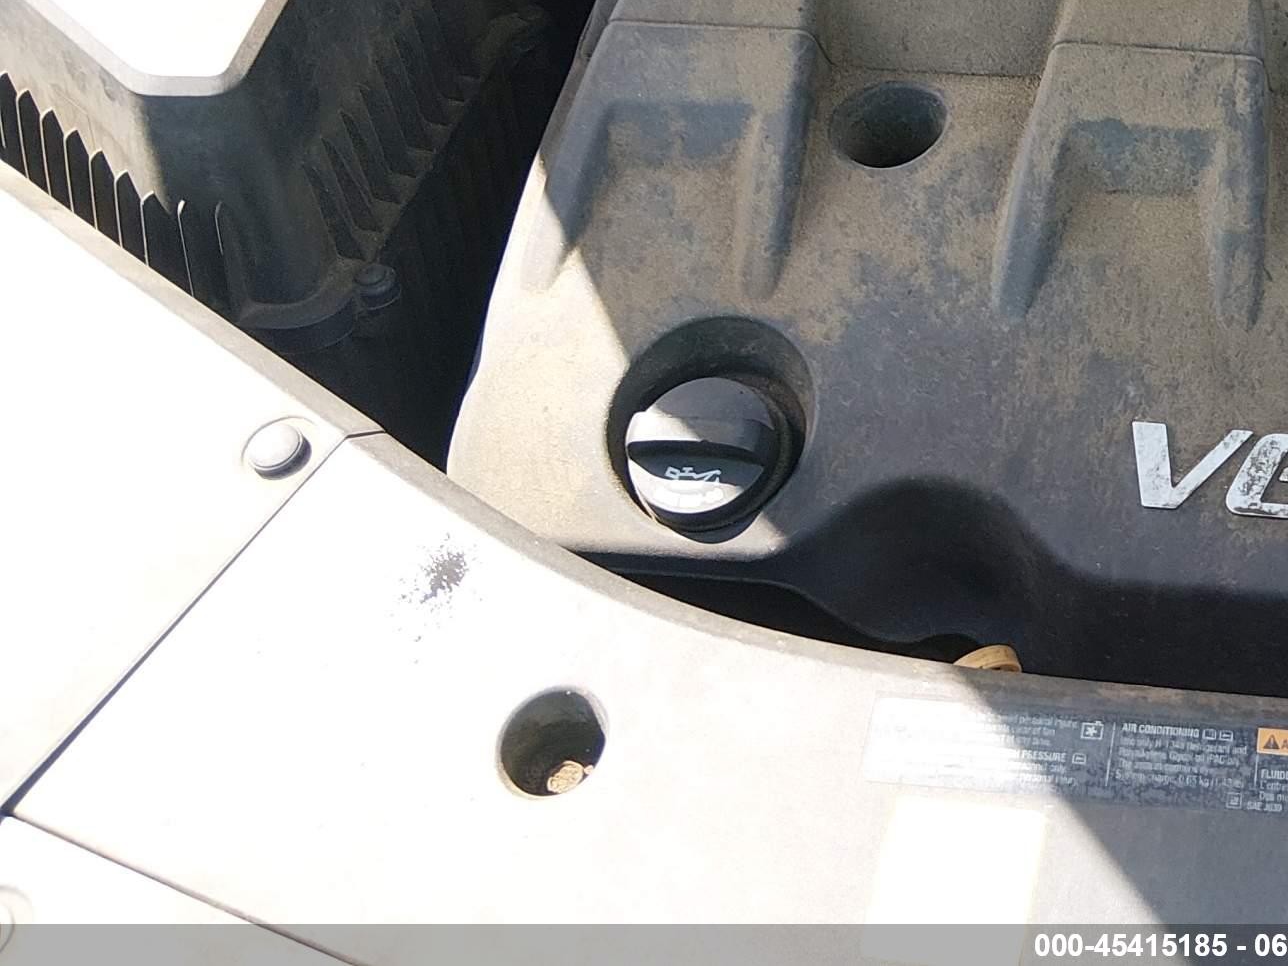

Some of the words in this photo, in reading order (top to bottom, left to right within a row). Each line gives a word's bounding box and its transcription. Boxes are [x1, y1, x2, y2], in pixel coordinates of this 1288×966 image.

[1121, 722, 1138, 734] AIR
[1139, 724, 1200, 738] CONDITIONING
[1022, 750, 1066, 763] PRESSURE
